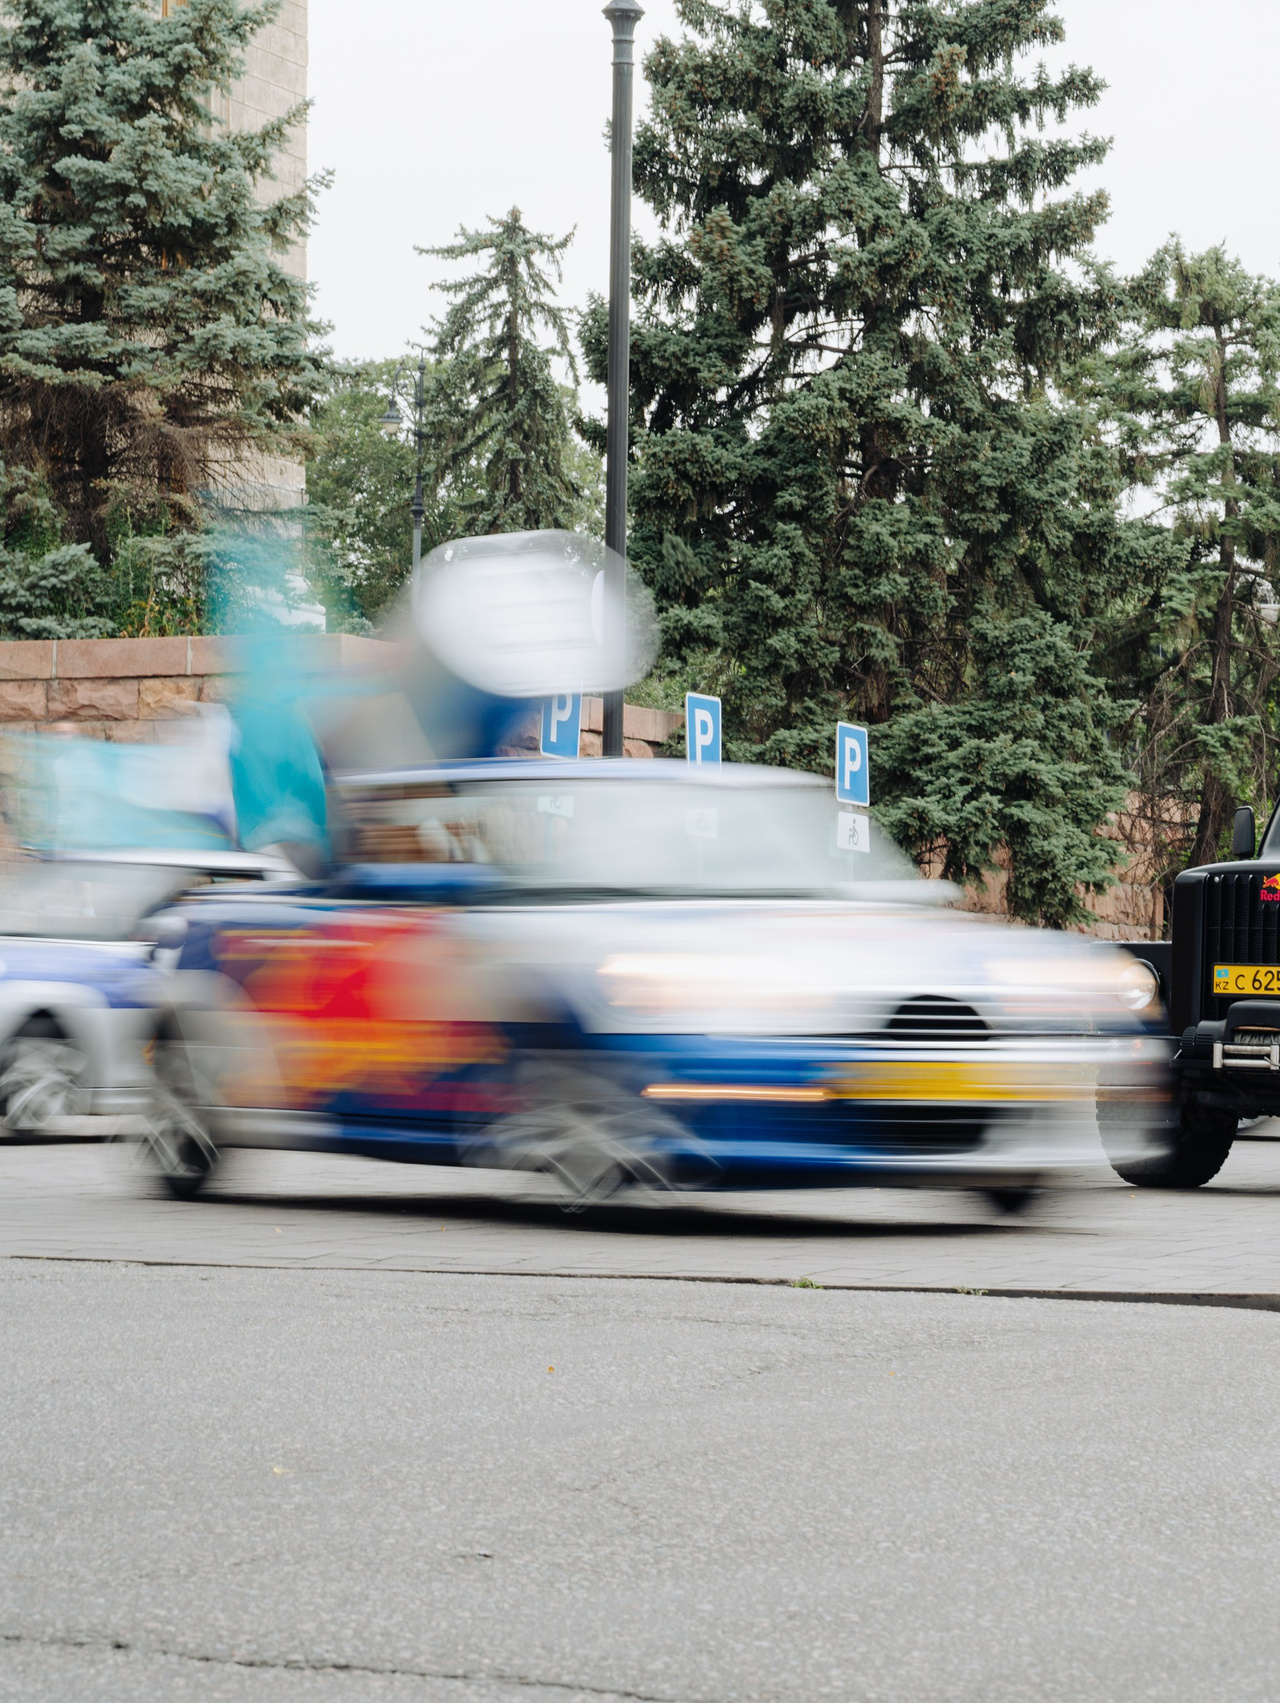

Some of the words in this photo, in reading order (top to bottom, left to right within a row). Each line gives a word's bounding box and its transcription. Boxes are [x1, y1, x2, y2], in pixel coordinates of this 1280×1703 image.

[550, 691, 572, 743] P
[694, 708, 714, 766] P
[844, 736, 862, 790] P
[1260, 889, 1280, 901] Red
[1215, 981, 1229, 991] KZ
[1235, 974, 1246, 991] C
